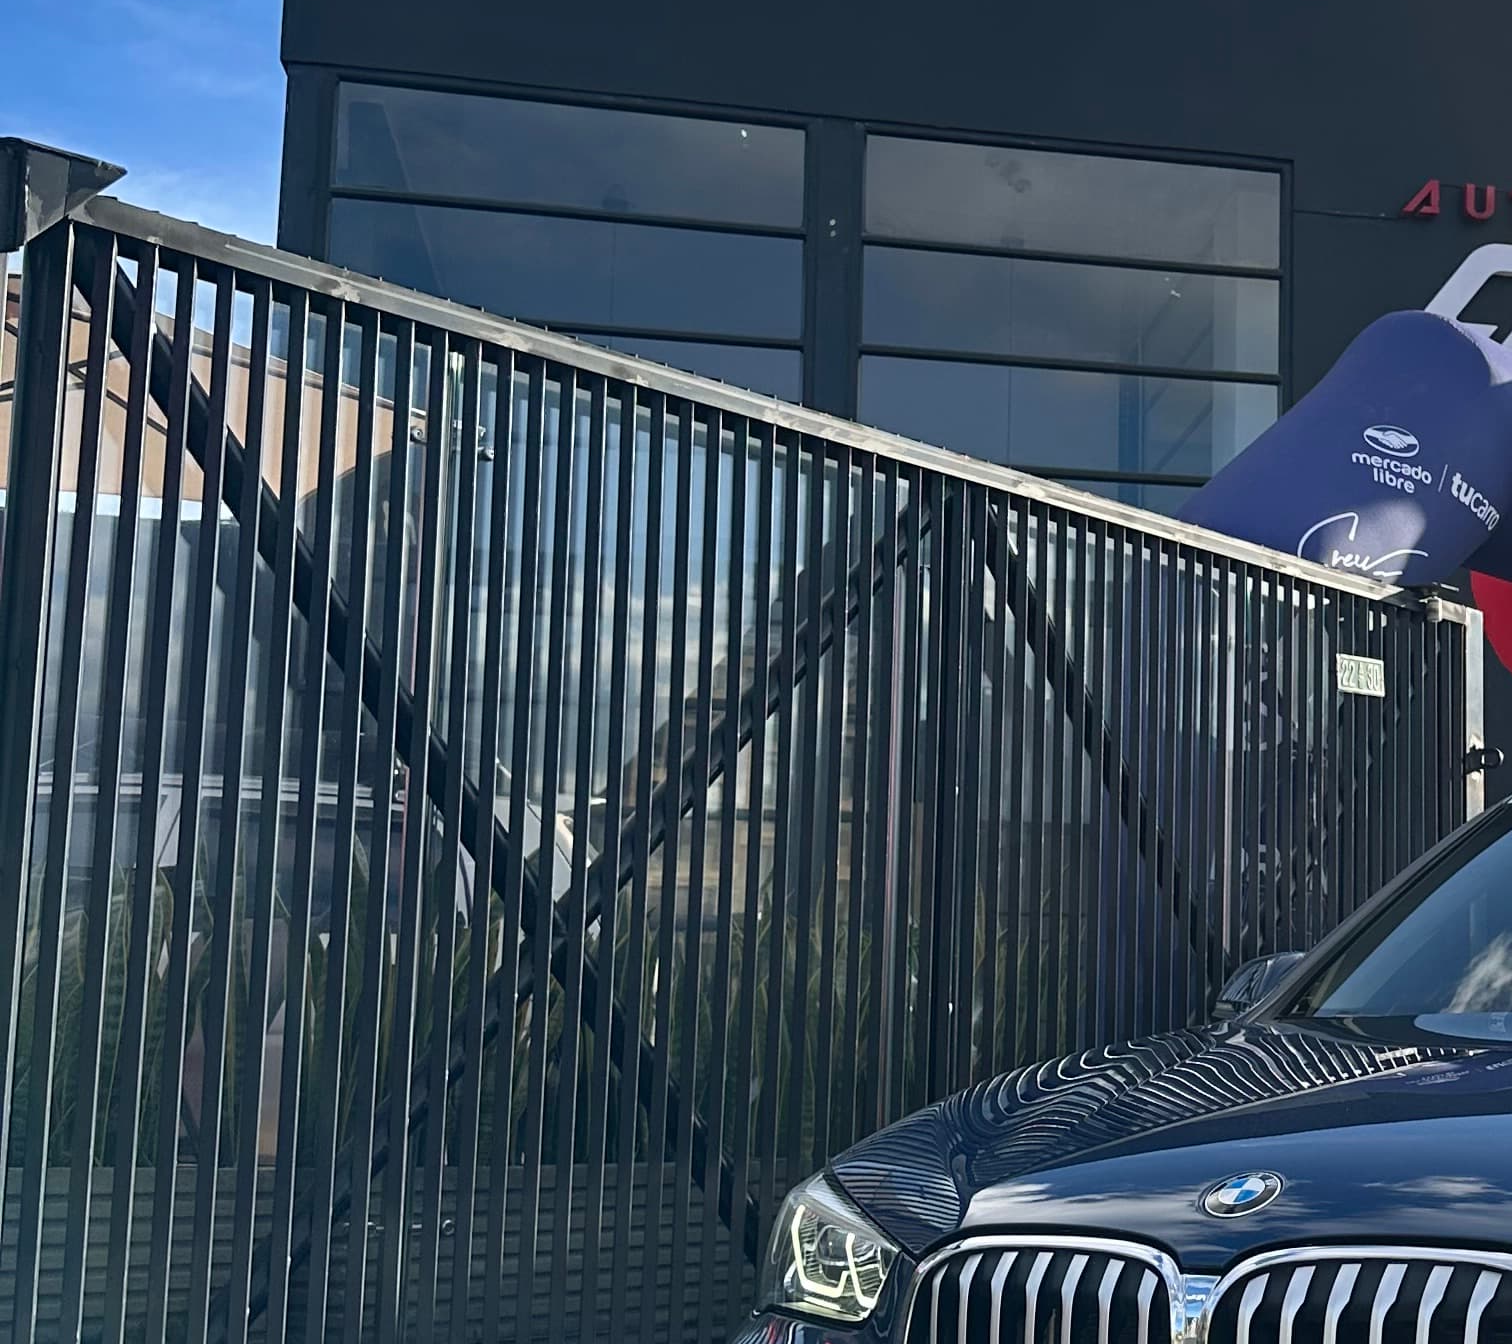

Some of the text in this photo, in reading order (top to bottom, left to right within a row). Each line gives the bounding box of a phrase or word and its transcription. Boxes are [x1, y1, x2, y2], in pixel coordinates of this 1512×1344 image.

[1351, 452, 1433, 486] mercado
[1373, 467, 1416, 495] libre
[1451, 471, 1501, 533] tucarro
